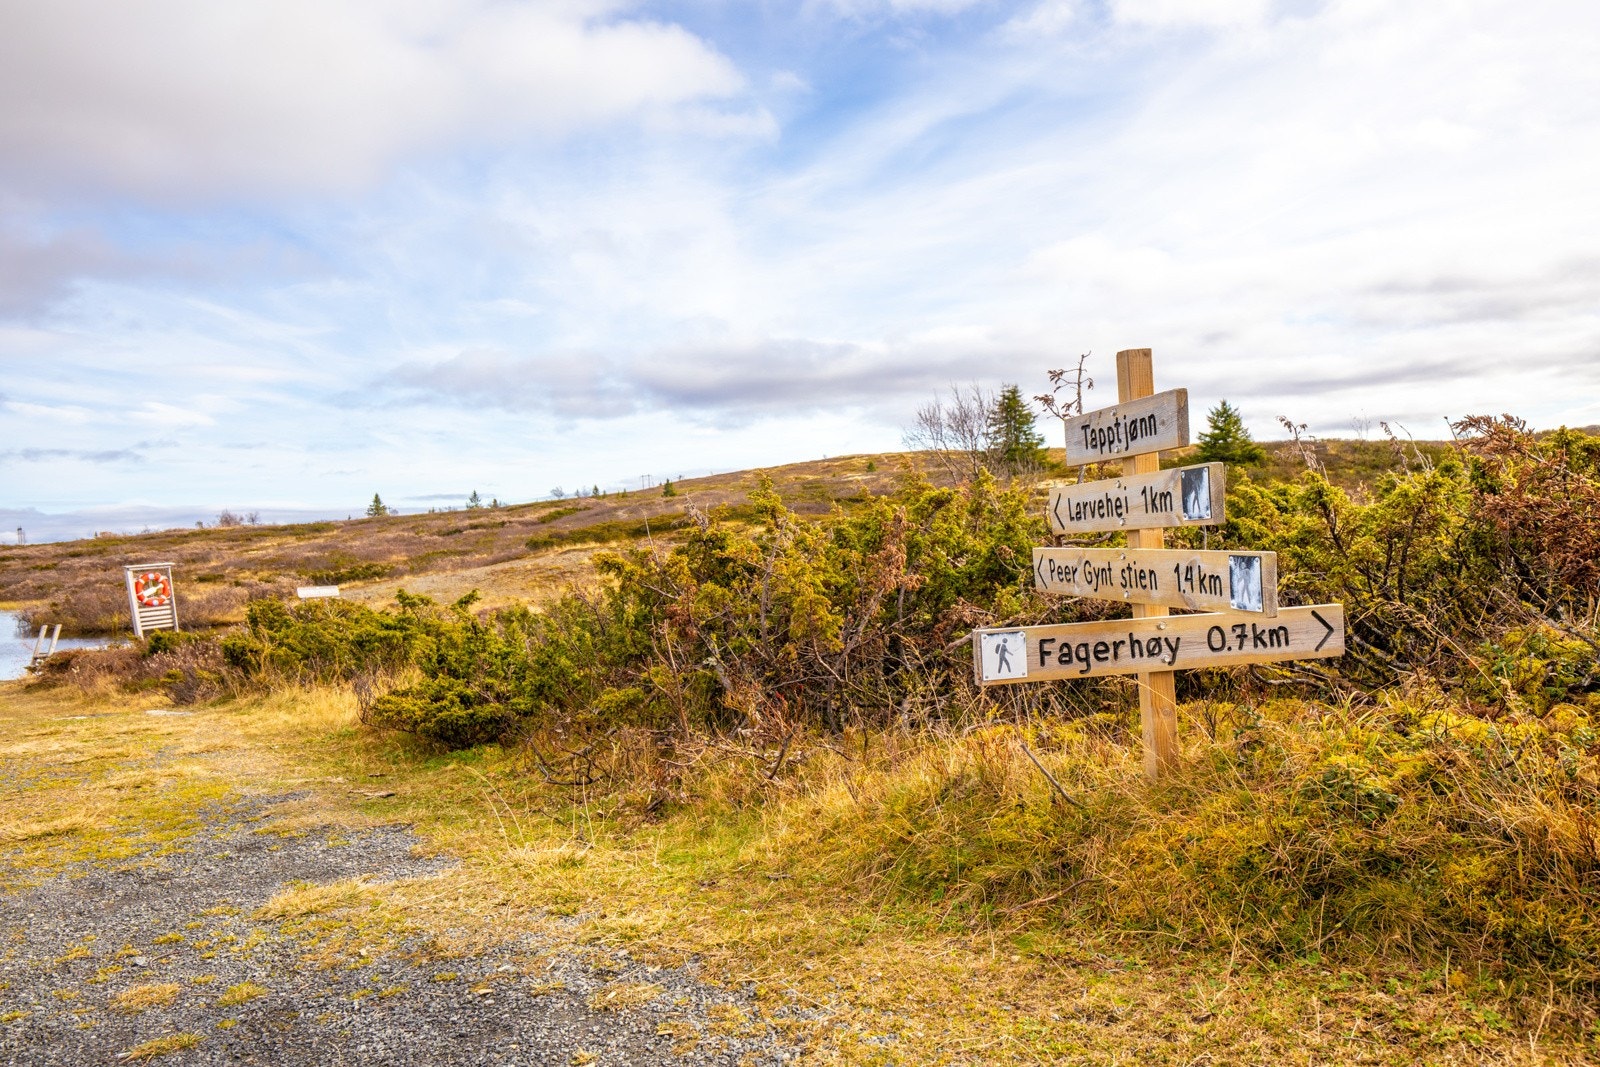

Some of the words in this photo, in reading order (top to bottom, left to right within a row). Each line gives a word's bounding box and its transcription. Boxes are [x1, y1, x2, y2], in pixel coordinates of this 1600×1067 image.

[1081, 413, 1157, 454] Tapptjønn
[1067, 486, 1129, 522] Larvehei
[1141, 485, 1173, 514] 1km
[1048, 558, 1078, 584] Peer
[1083, 559, 1114, 592] Gynt
[1120, 561, 1158, 590] stien
[1038, 632, 1181, 675] Fagerhøy
[1206, 622, 1290, 653] 0.7km
